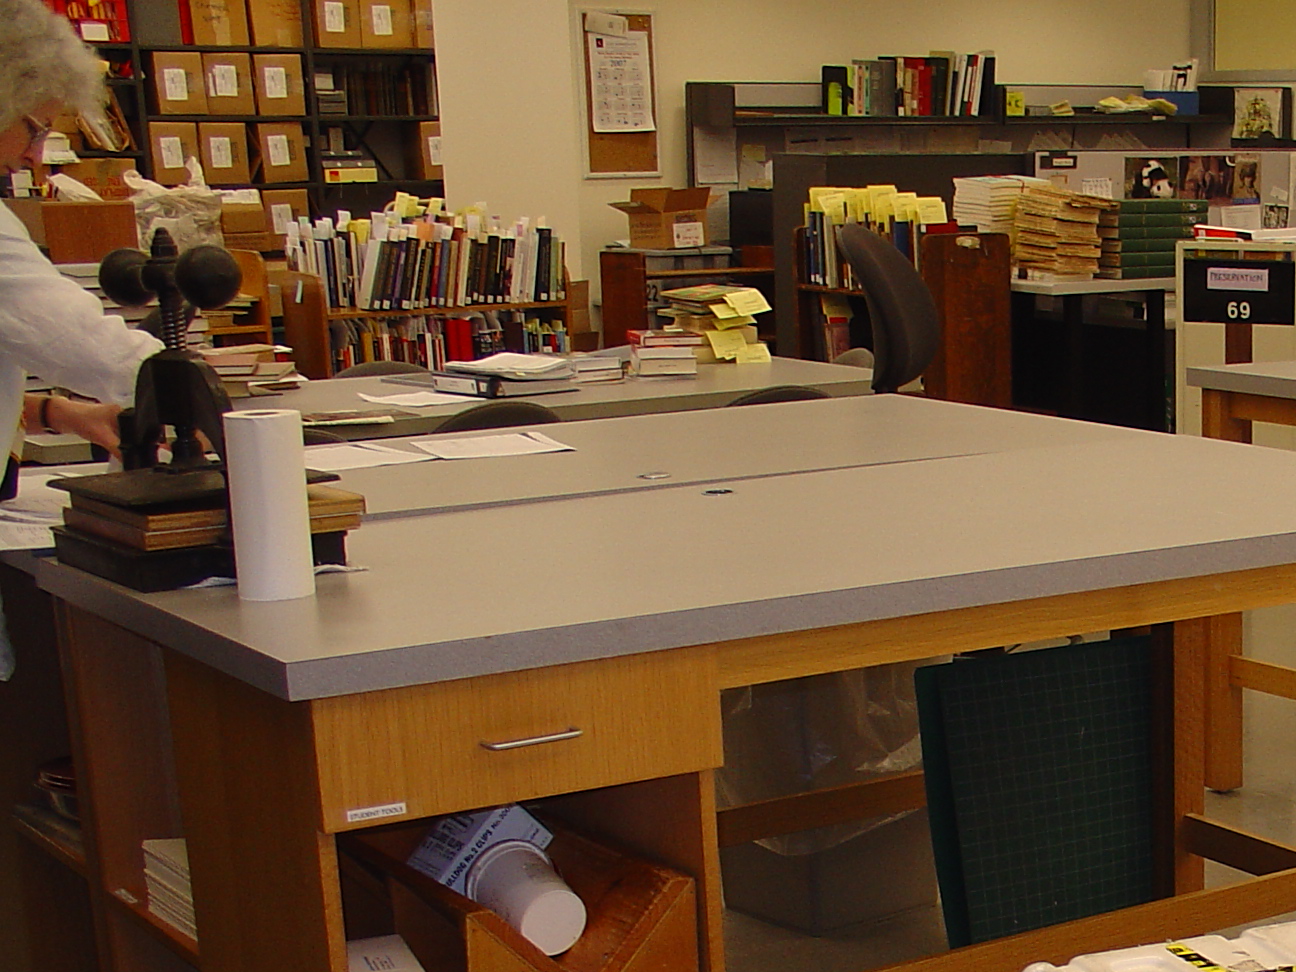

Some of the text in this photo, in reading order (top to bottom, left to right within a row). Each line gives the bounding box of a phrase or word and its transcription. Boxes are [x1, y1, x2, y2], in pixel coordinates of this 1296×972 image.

[1209, 271, 1264, 283] PRESERVATION
[1227, 301, 1251, 319] 69
[350, 809, 379, 820] STUDENT
[445, 862, 467, 888] ULLDOG
[475, 829, 494, 849] CLIPS
